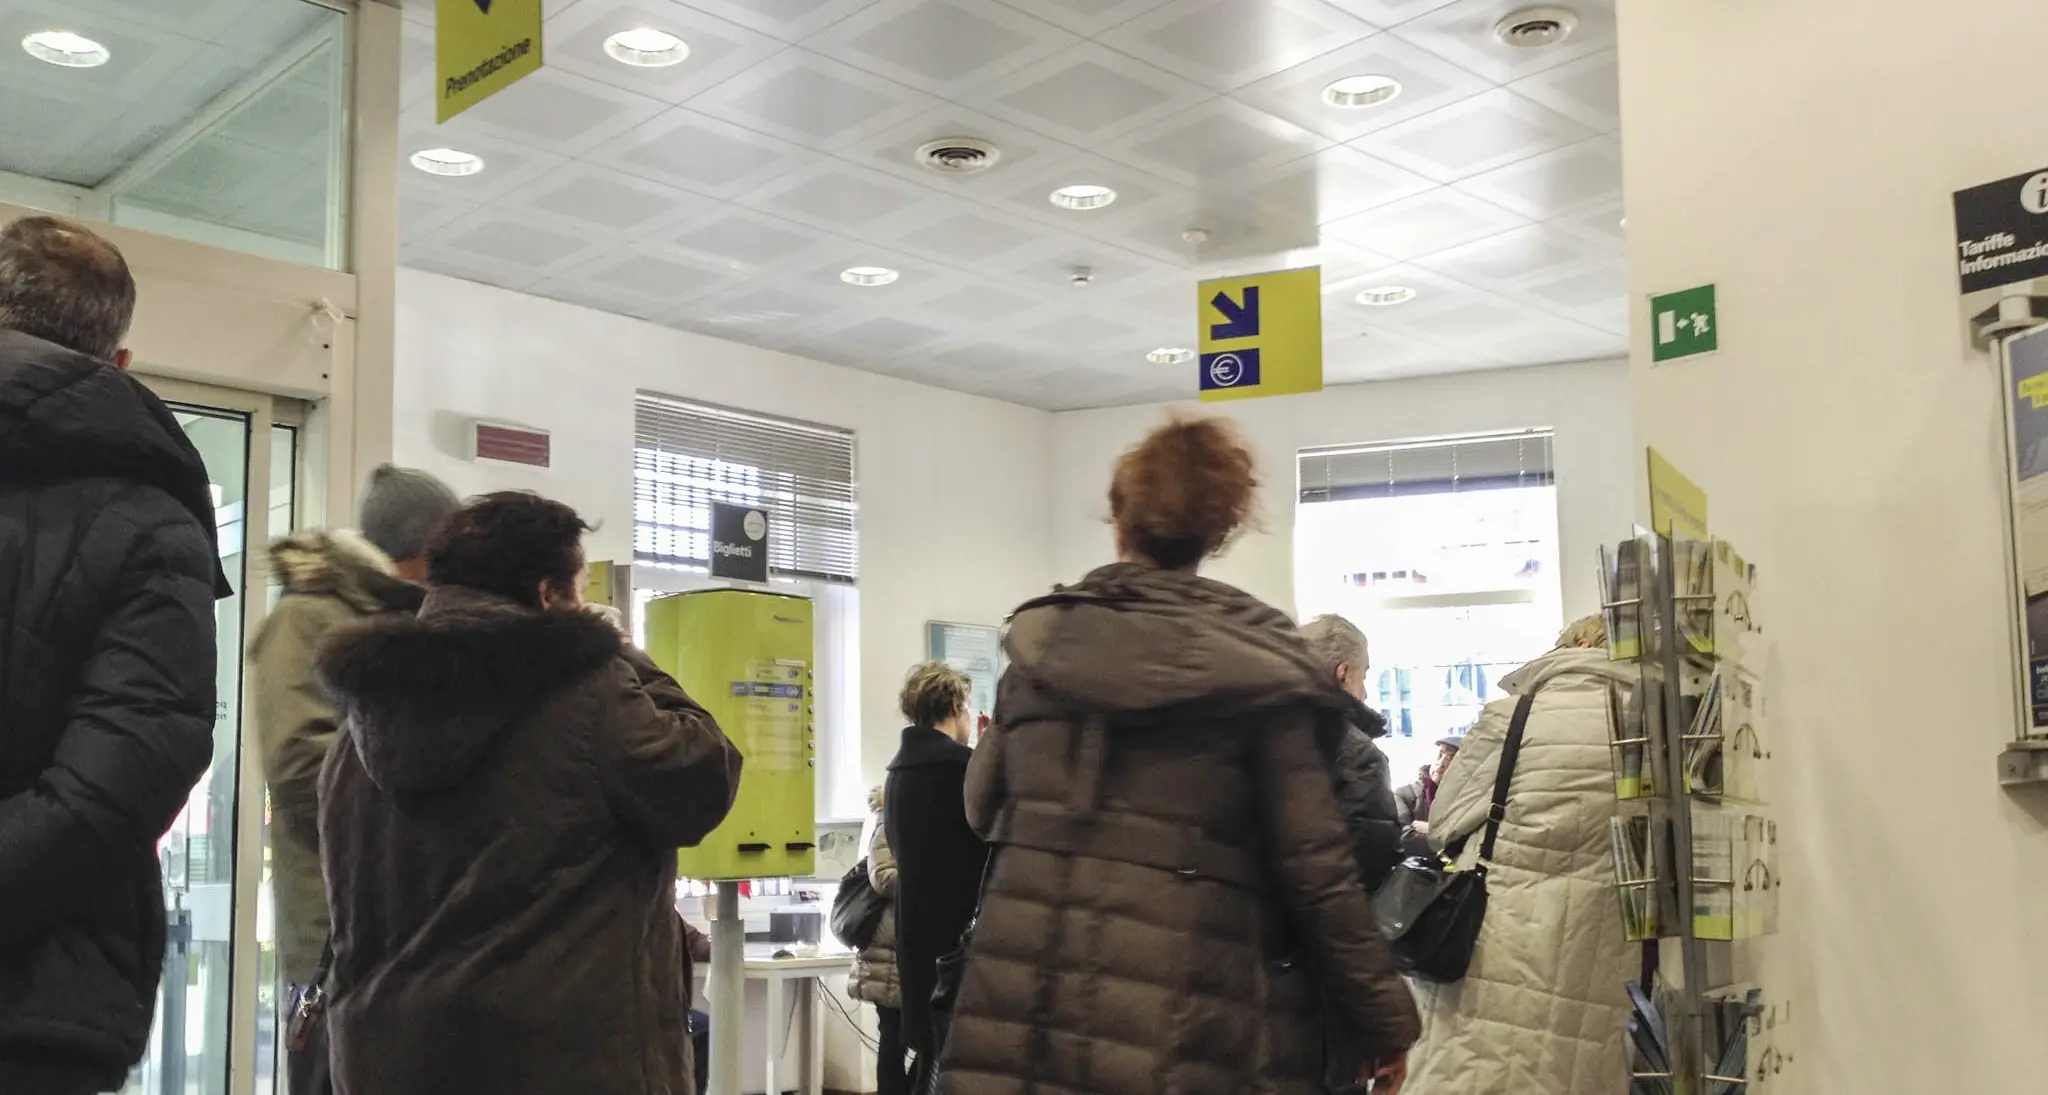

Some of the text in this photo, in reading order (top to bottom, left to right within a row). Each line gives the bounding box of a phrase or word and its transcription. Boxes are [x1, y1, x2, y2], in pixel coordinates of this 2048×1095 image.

[444, 38, 530, 99] Prenotazione
[1959, 232, 2015, 257] Tariffe
[713, 541, 752, 557] Biglietti
